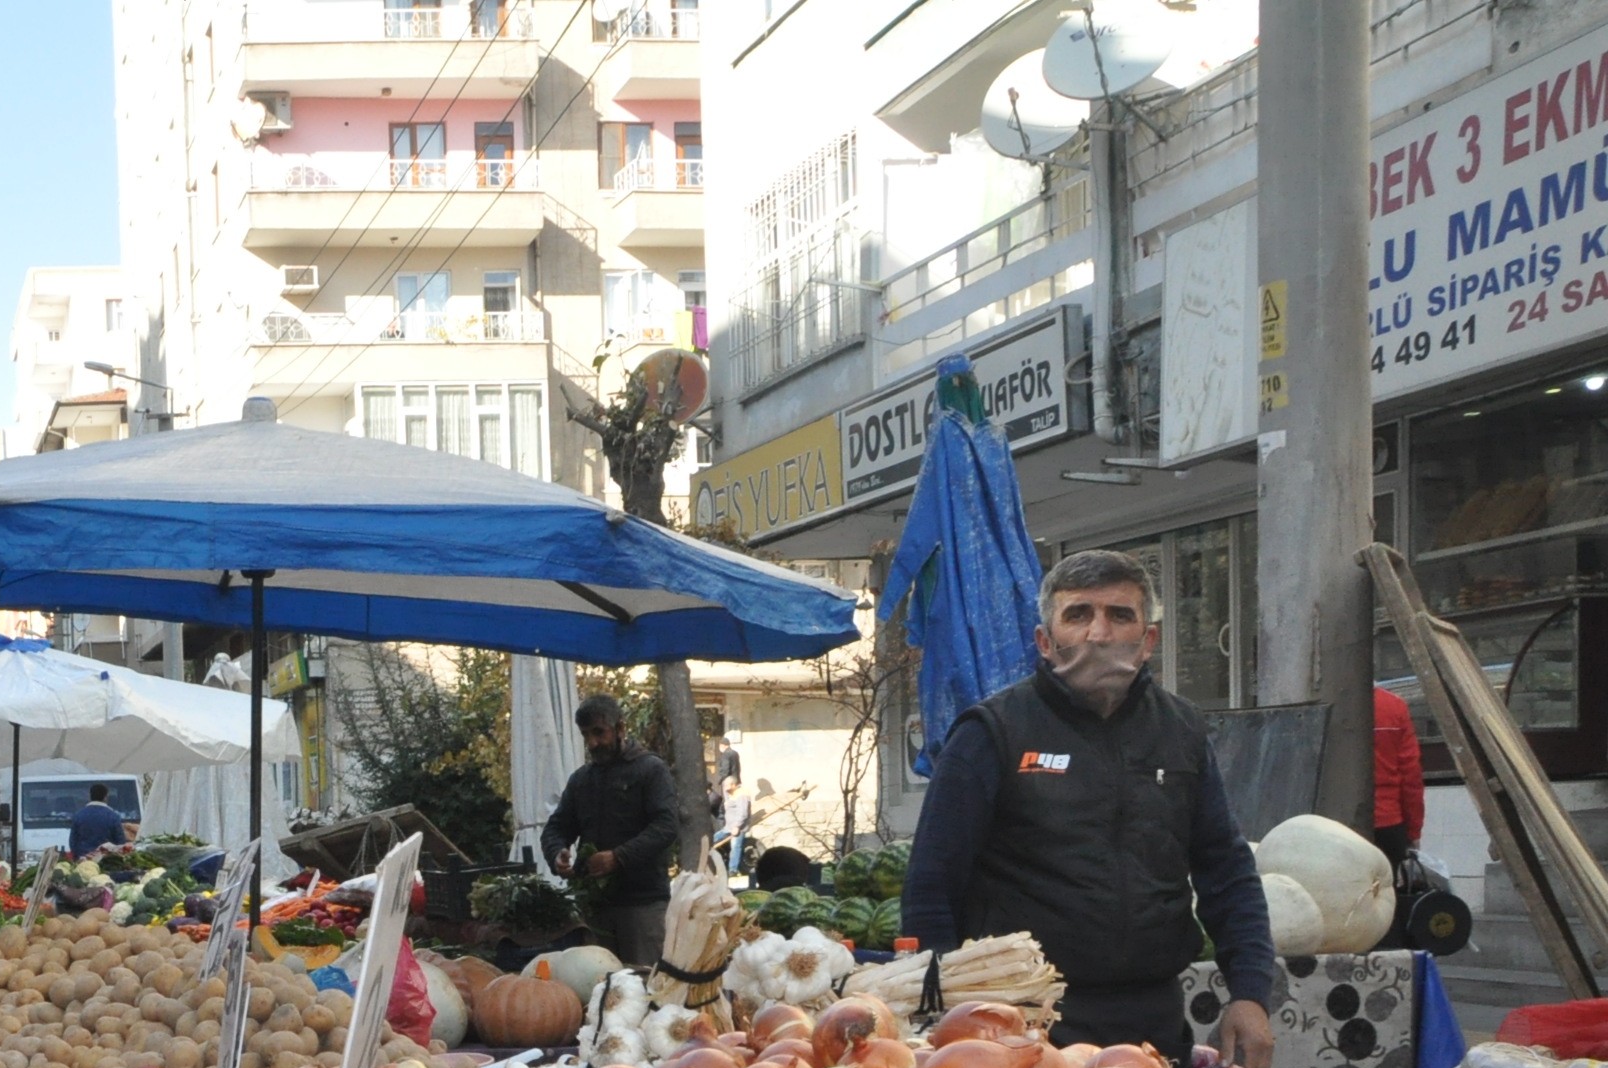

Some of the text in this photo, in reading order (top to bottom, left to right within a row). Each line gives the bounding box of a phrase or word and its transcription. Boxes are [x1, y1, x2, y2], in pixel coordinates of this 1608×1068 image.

[1456, 115, 1481, 184] 3
[1369, 229, 1416, 291] U
[1369, 225, 1608, 338] LÜ SİPARİŞ K
[1395, 331, 1431, 365] 49
[1441, 314, 1476, 350] 41
[1506, 291, 1549, 333] 24
[848, 358, 1053, 469] DOSTLA UAFÖR
[1030, 411, 1056, 432] TALİP
[748, 450, 830, 531] YUFKA
